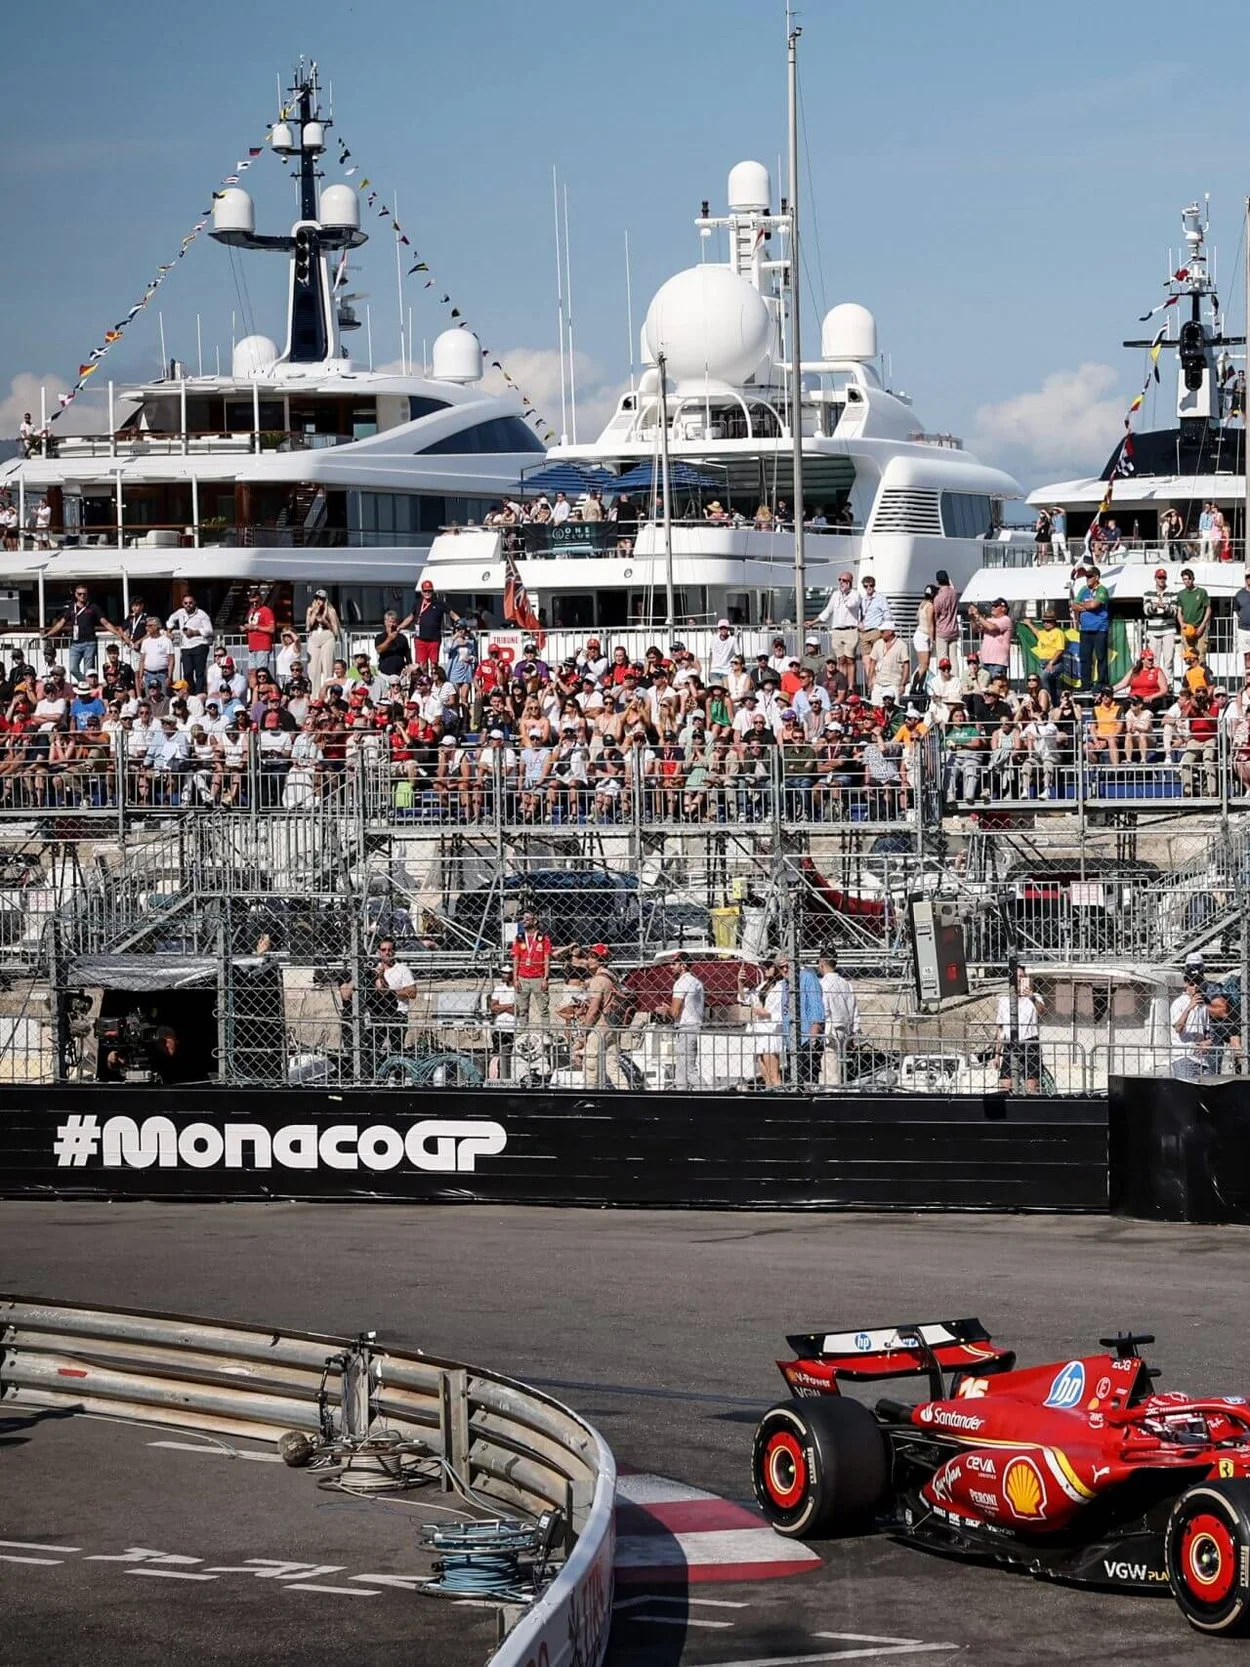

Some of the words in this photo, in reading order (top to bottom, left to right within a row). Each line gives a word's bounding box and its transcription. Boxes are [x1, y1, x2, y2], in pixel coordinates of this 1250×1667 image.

[564, 526, 591, 534] ONE
[493, 636, 518, 644] TRIBUNE
[53, 1115, 507, 1172] #MonacoGP
[855, 1334, 872, 1350] hp
[797, 1372, 831, 1388] V-Power
[1049, 1363, 1083, 1407] hp
[934, 1407, 985, 1431] Santander
[969, 1488, 998, 1507] PERONI
[1104, 1560, 1148, 1580] VGW
